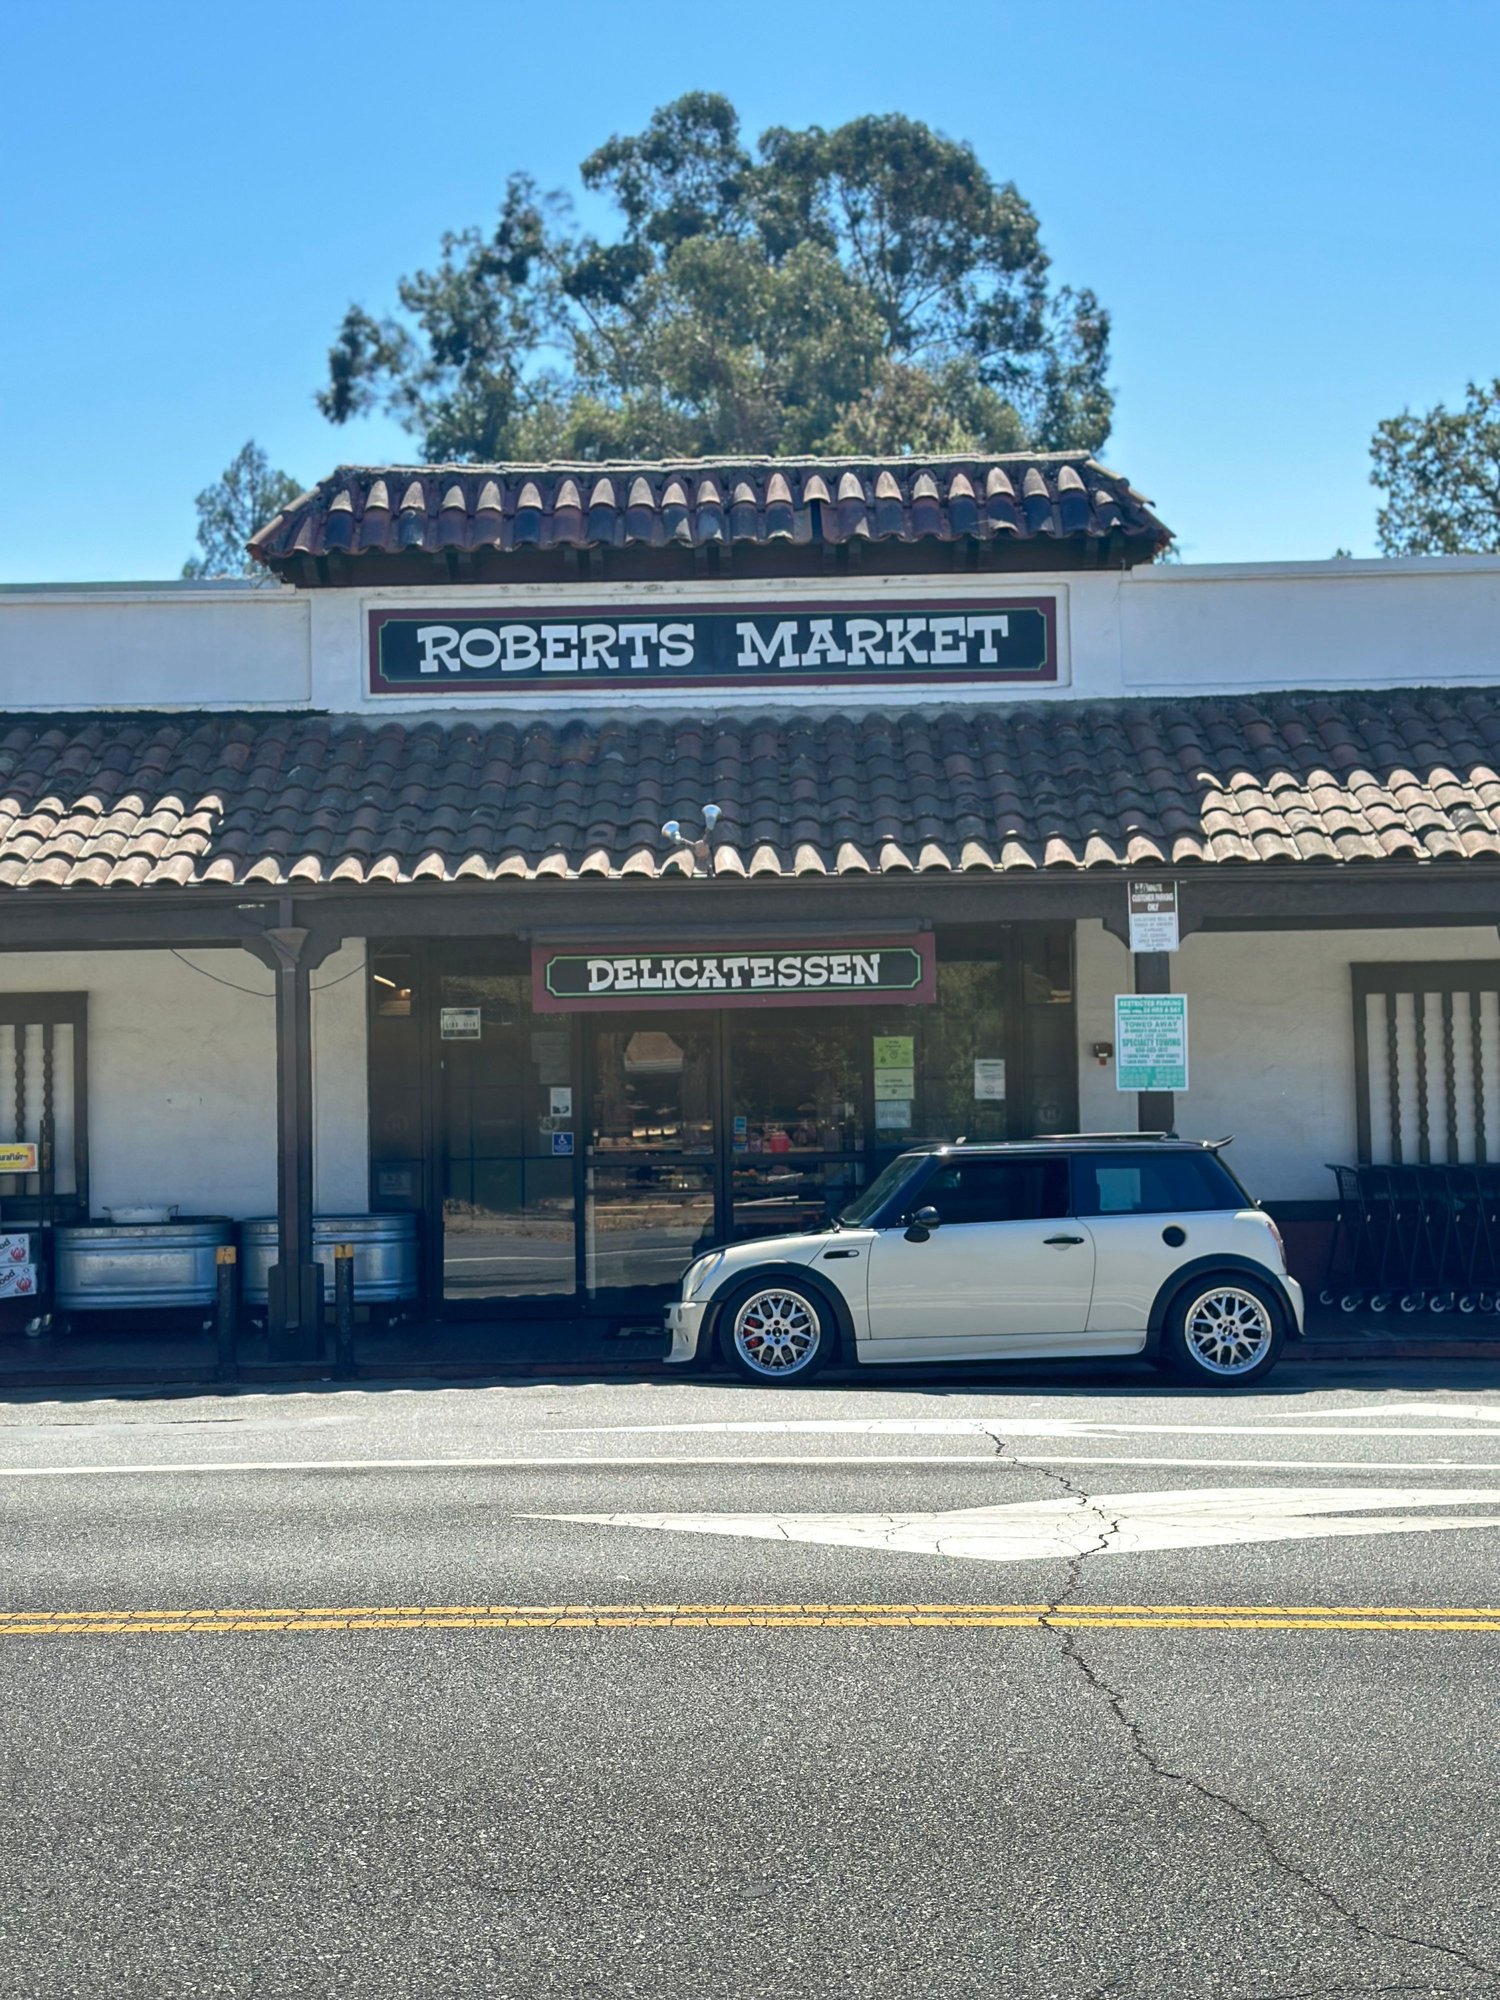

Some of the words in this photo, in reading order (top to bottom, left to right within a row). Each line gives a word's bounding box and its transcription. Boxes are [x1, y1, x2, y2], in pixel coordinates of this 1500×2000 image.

[417, 623, 694, 673] ROBERTS
[736, 615, 1009, 668] MARKET
[587, 953, 880, 991] DELICATESSEN
[1122, 1038, 1154, 1047] SPECIALTY
[1155, 1038, 1181, 1047] TOWING
